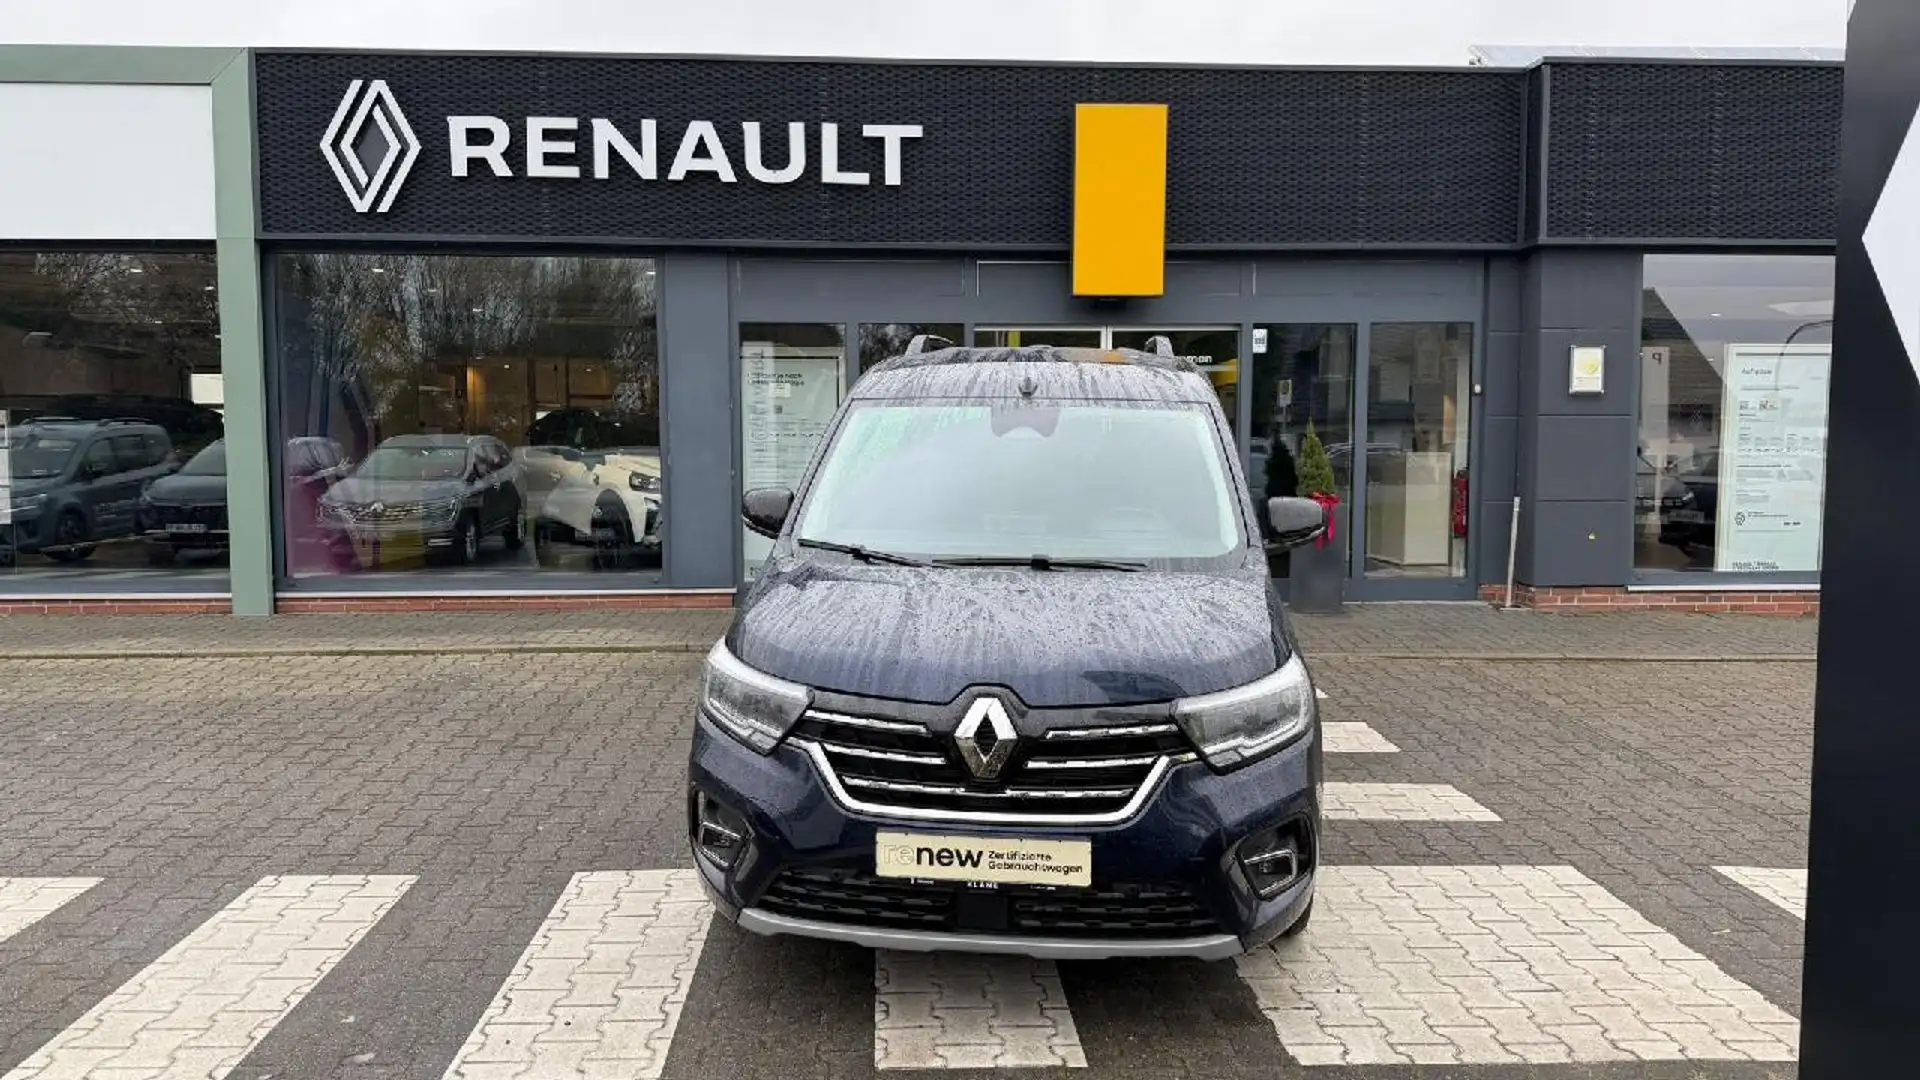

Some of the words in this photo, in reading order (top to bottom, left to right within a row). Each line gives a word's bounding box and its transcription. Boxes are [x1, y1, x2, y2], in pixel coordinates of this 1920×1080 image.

[447, 115, 923, 186] RENAULT
[883, 844, 984, 868] renew
[988, 850, 1052, 861] Zertifizierte
[988, 861, 1083, 875] Gebrauchtwagen
